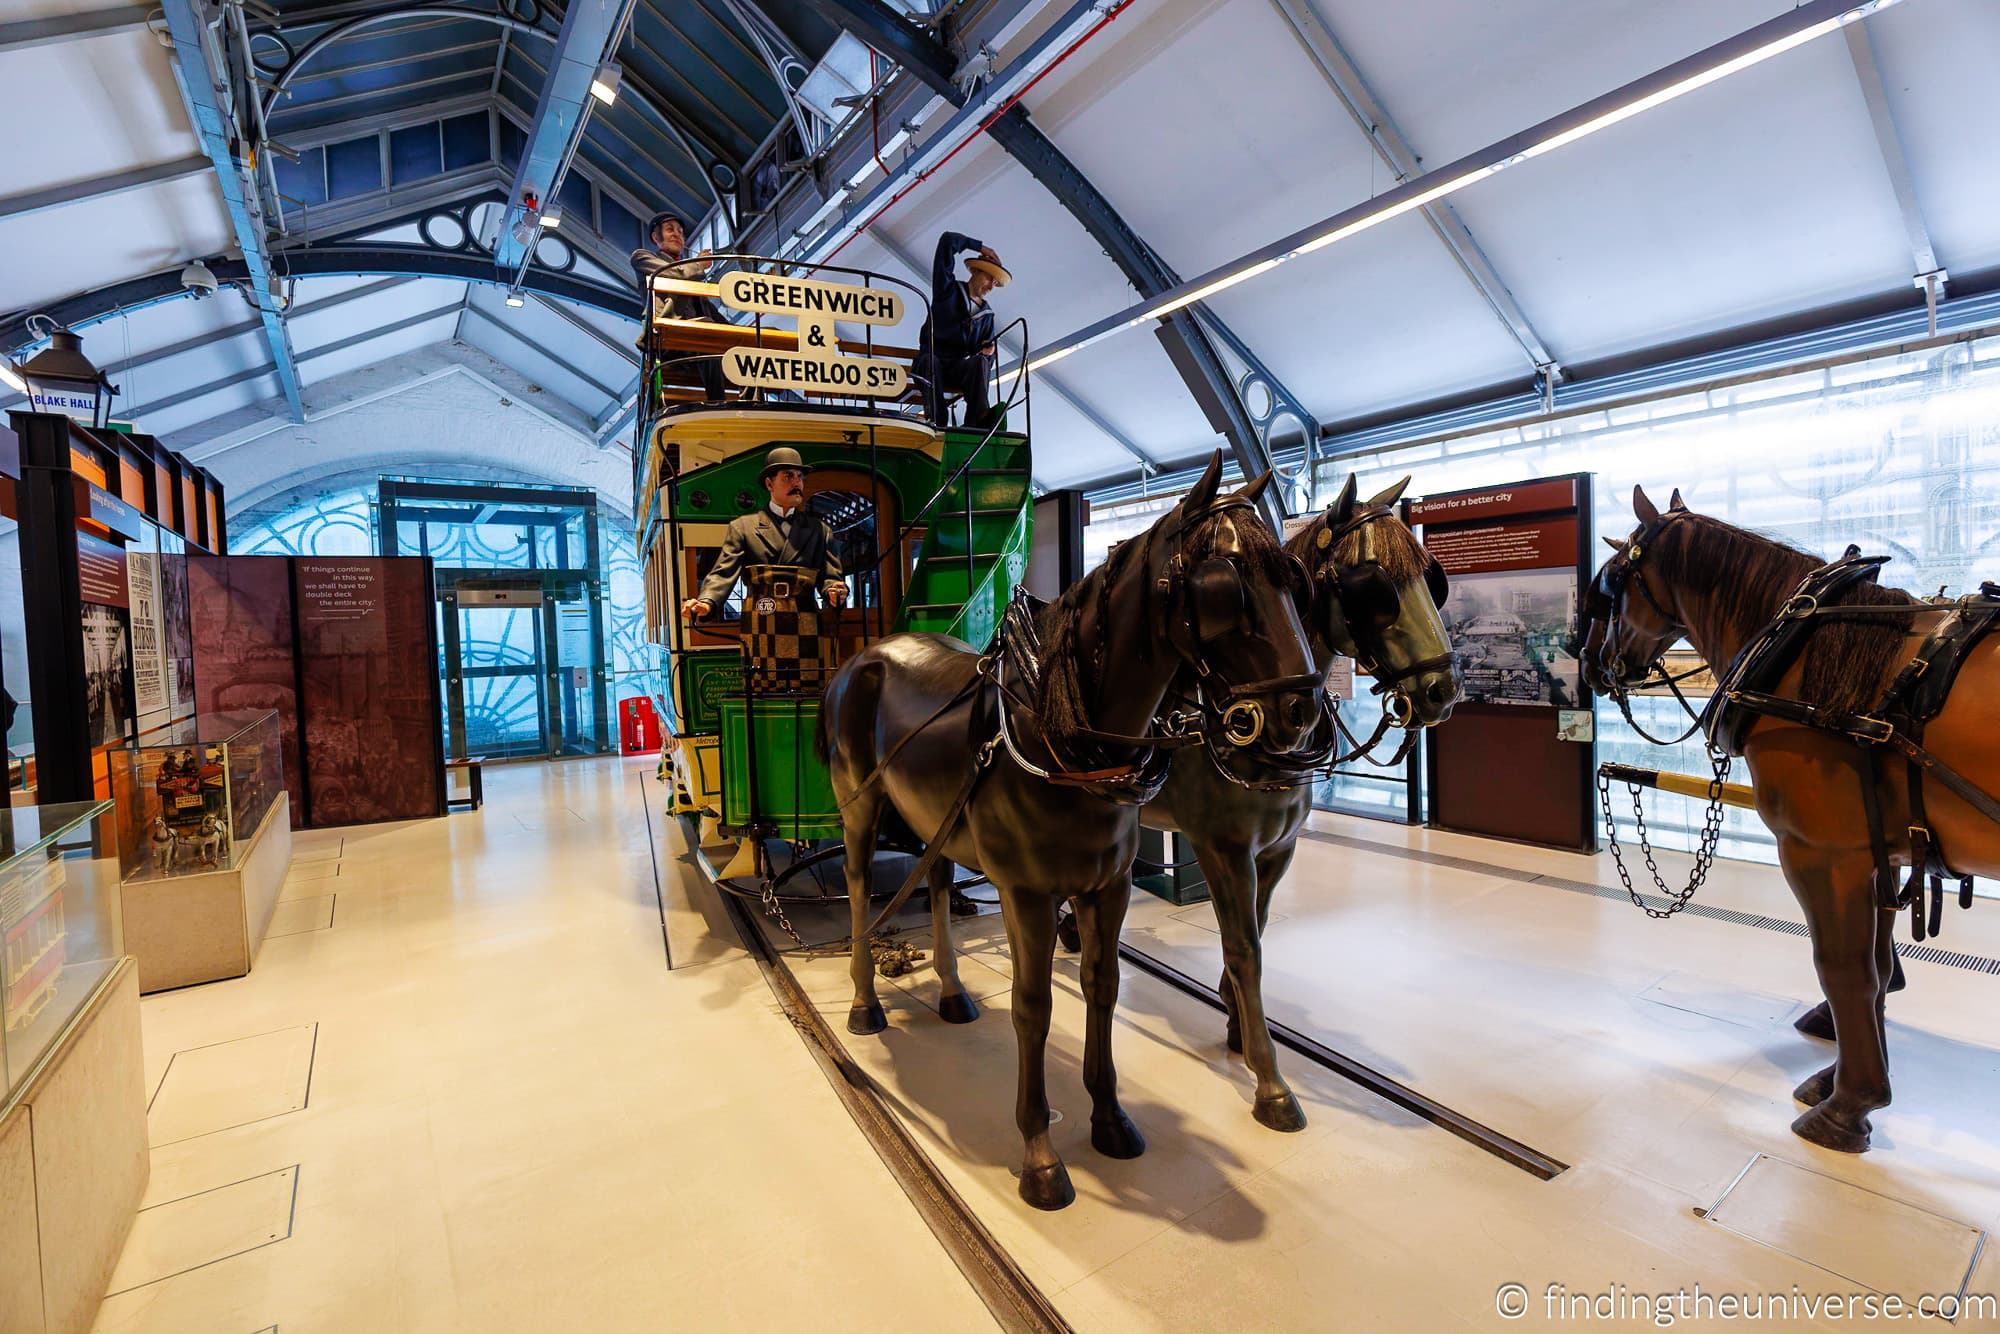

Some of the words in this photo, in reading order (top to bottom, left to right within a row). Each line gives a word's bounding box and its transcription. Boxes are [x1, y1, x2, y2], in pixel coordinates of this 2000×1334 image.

[734, 280, 893, 318] GREENWICH
[807, 325, 826, 347] &
[734, 354, 861, 385] WATERLOO
[34, 395, 67, 406] BLAKE
[70, 398, 96, 409] HALL
[1411, 505, 1423, 514] Big
[1424, 502, 1447, 511] vision
[1448, 500, 1460, 508] for
[1468, 496, 1494, 506] better
[1496, 493, 1512, 502] city
